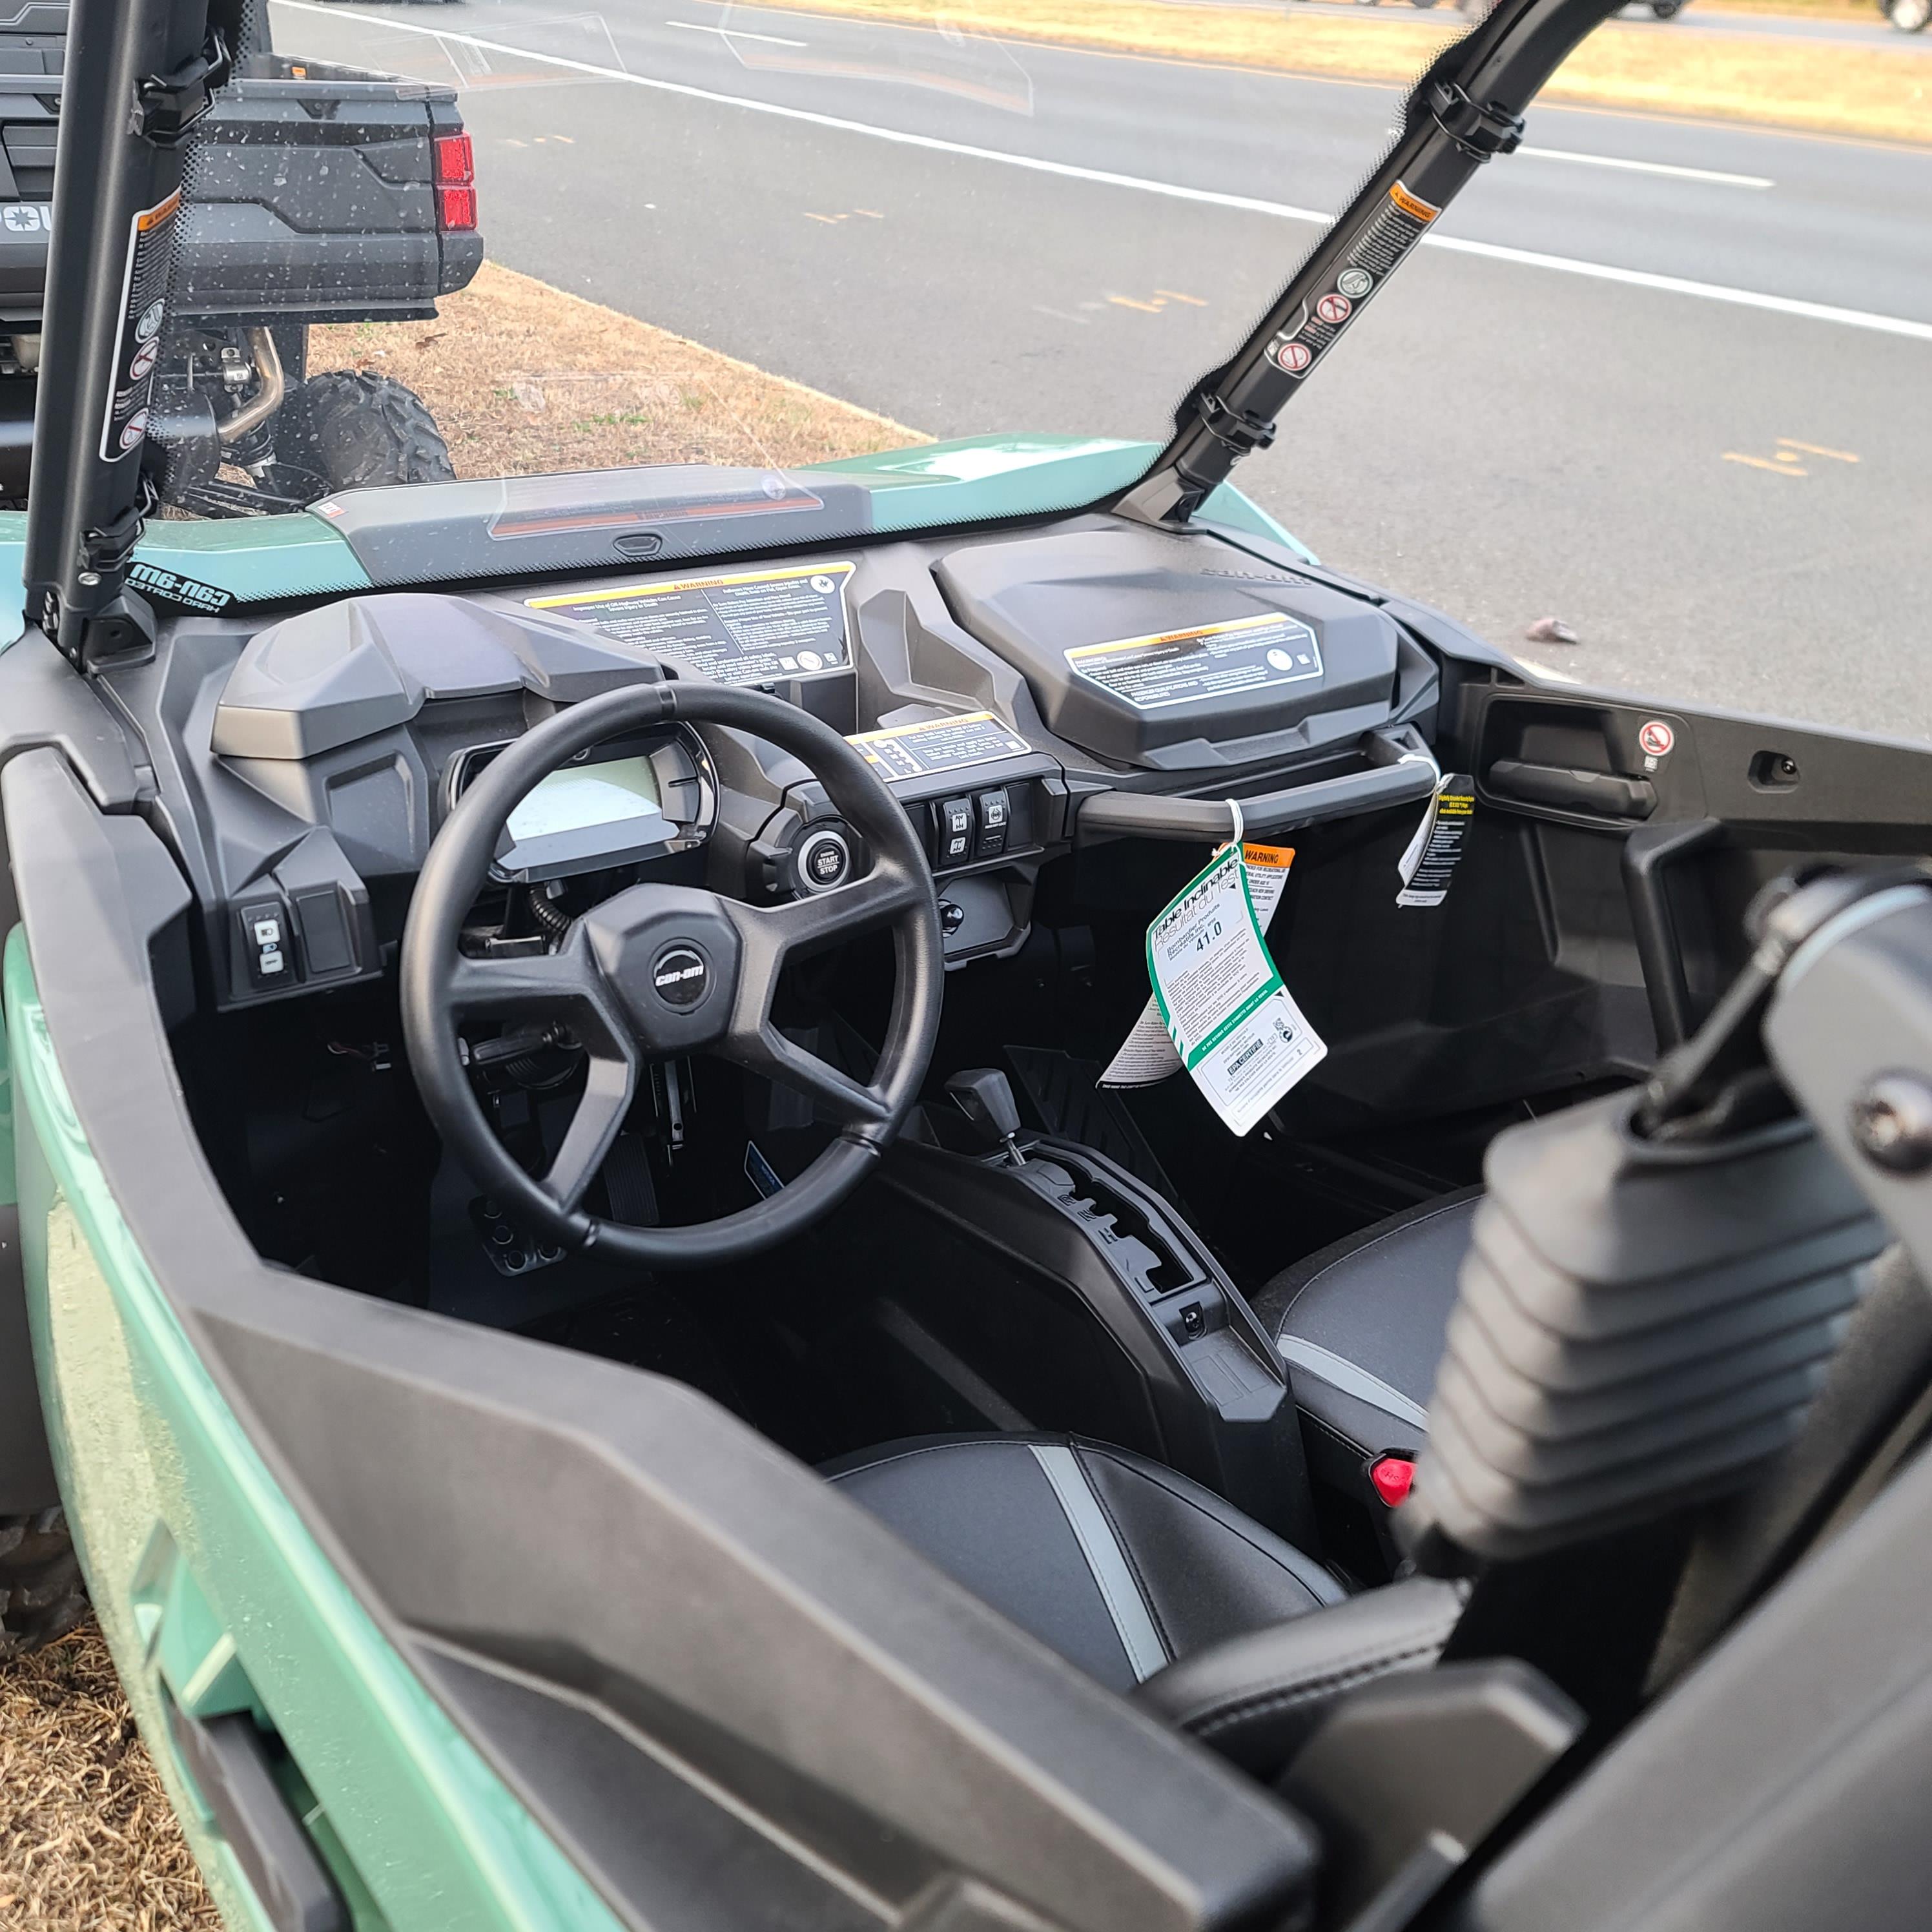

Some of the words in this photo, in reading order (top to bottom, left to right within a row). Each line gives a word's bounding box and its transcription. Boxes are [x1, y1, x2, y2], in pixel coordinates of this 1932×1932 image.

[680, 579, 724, 590] WARNING
[927, 718, 968, 729] WARNING
[817, 855, 838, 866] START
[1245, 850, 1279, 864] WARNING
[820, 865, 838, 875] STOP
[1198, 892, 1215, 910] du
[1216, 868, 1239, 894] Test
[1153, 908, 1182, 940] Table
[1184, 858, 1238, 911] Inclinable
[1196, 921, 1222, 952] 41.0
[655, 966, 704, 986] can-am
[1229, 1062, 1240, 1073] EPA
[1238, 1040, 1262, 1064] CERTIFIÉ
[1098, 1228, 1118, 1244] H
[1135, 1277, 1155, 1293] L
